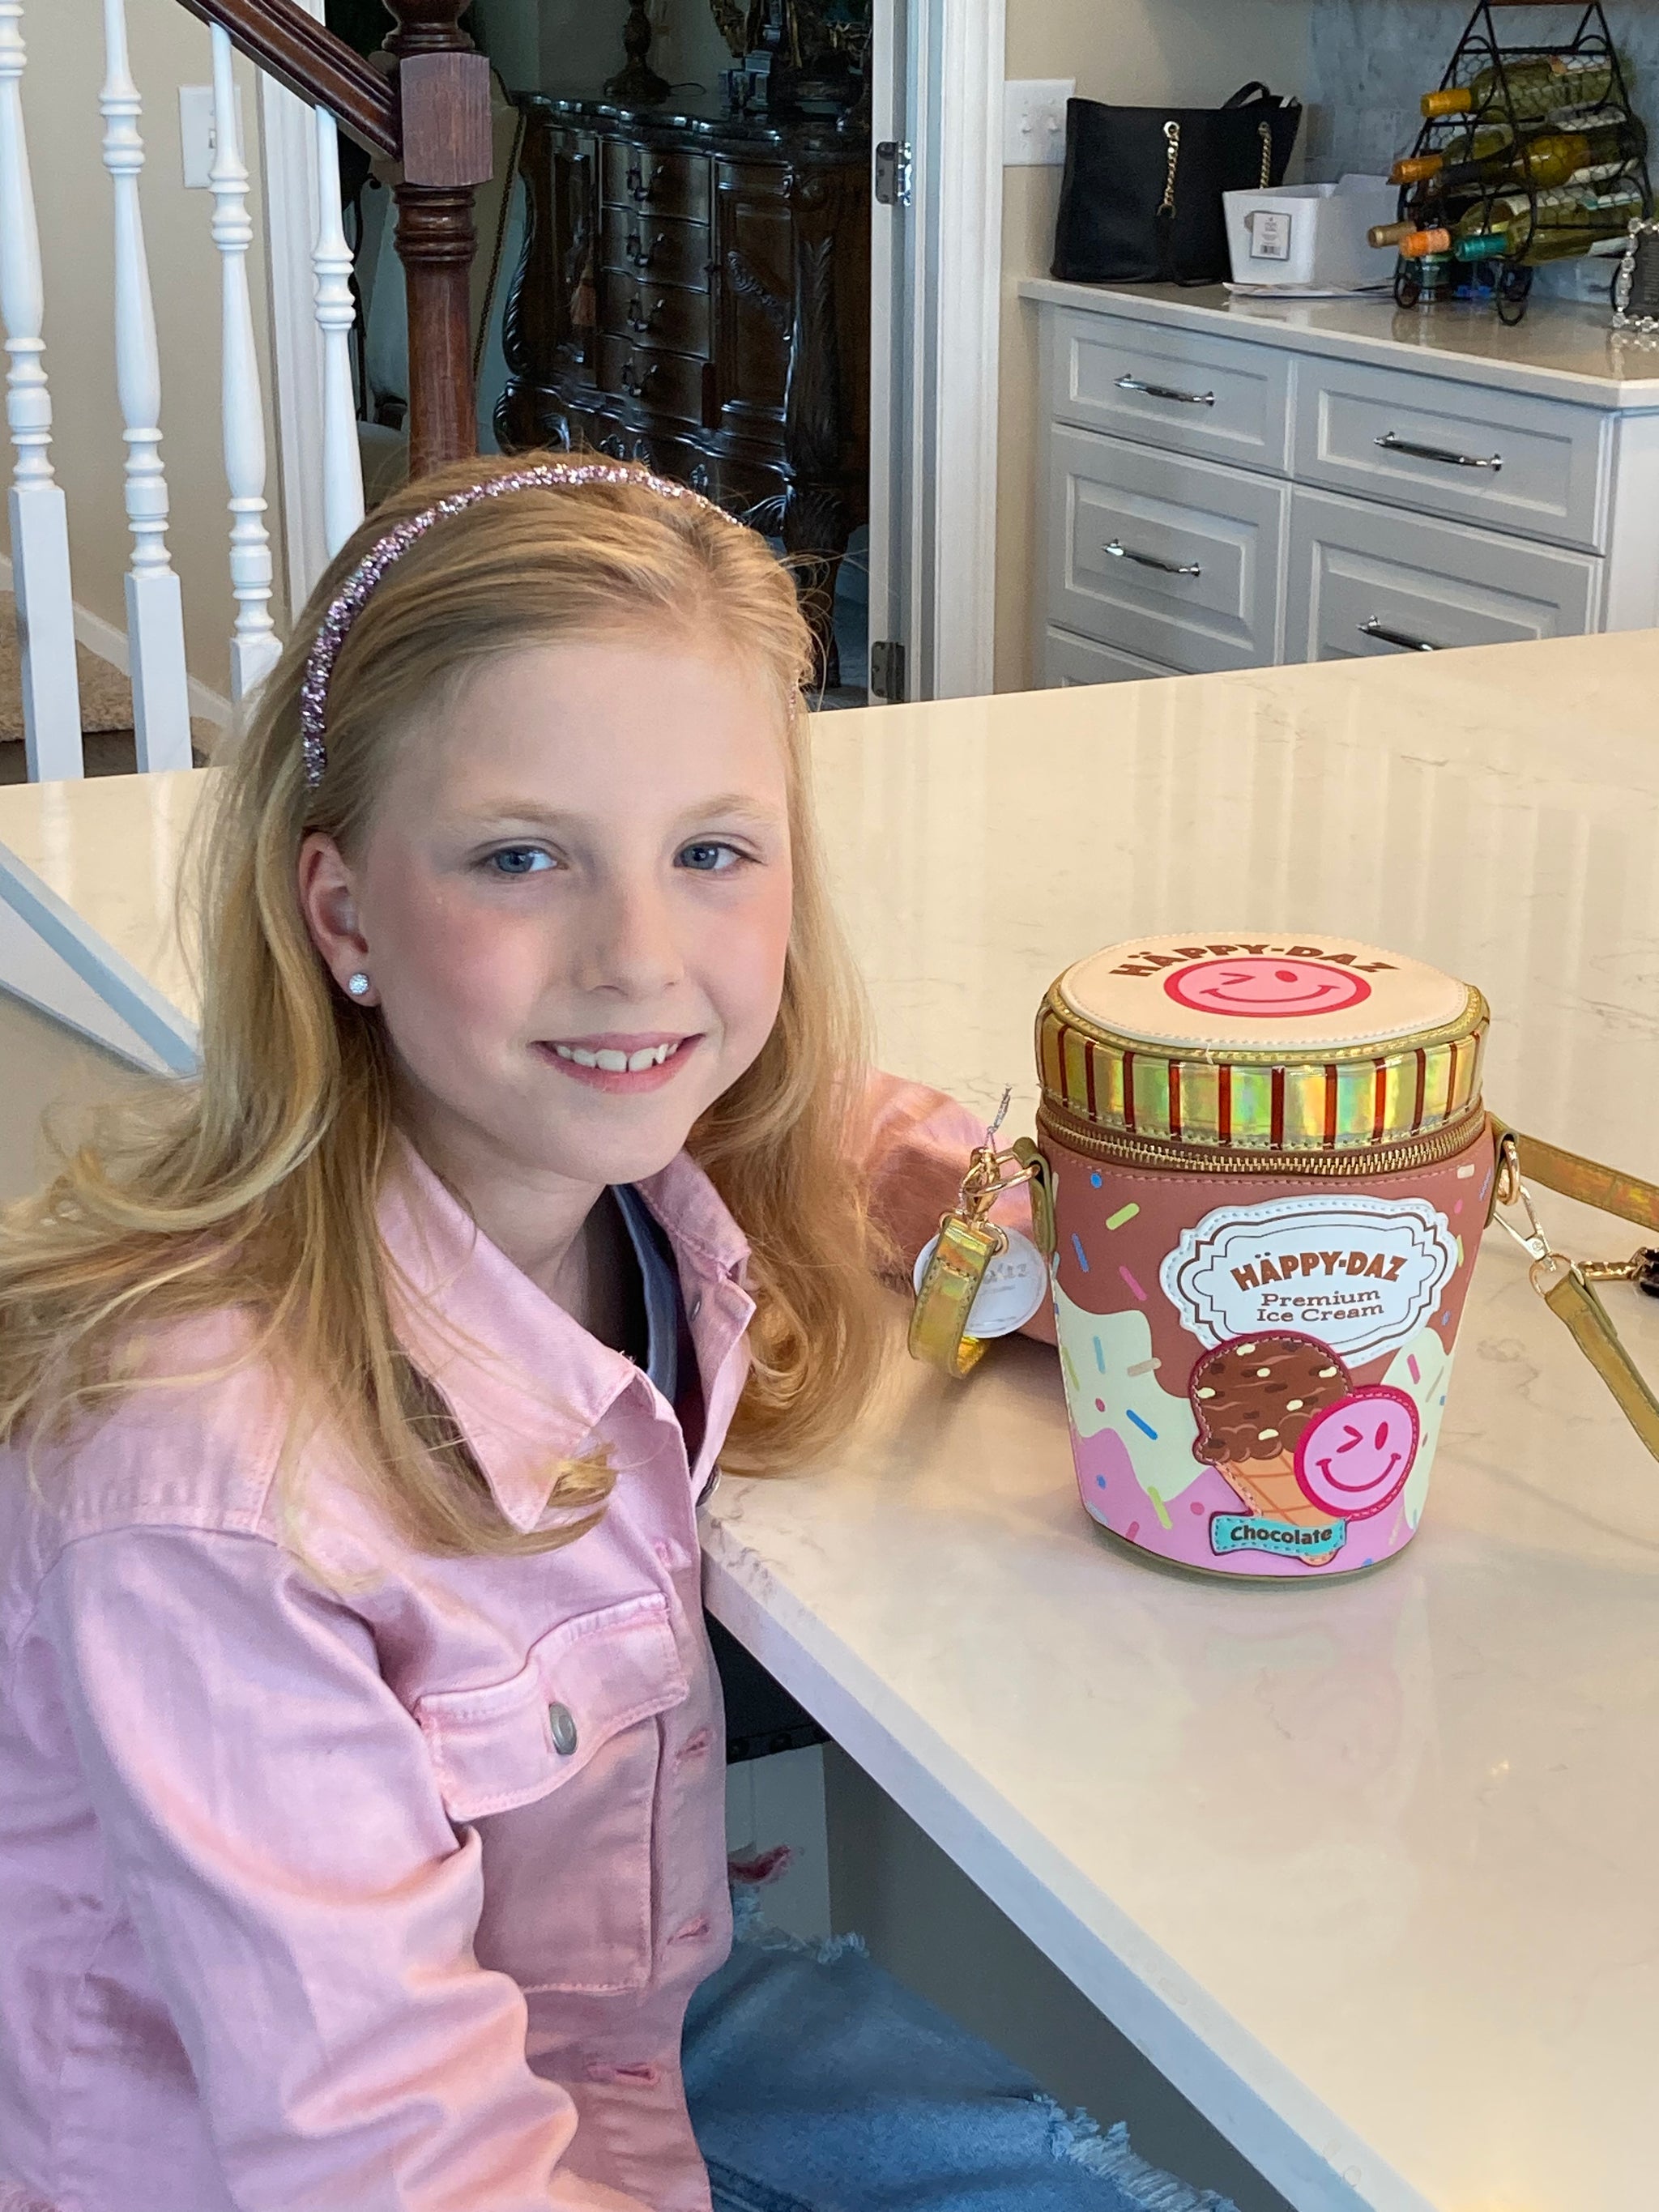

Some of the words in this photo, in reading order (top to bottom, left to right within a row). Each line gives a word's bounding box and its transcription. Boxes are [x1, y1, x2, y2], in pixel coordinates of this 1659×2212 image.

[1230, 1251, 1408, 1292] HÄPPY-DAZ
[1260, 1290, 1381, 1306] Premium
[1256, 1308, 1294, 1322] Ice
[1300, 1304, 1384, 1322] Cream
[1230, 1524, 1333, 1545] Chocolate
